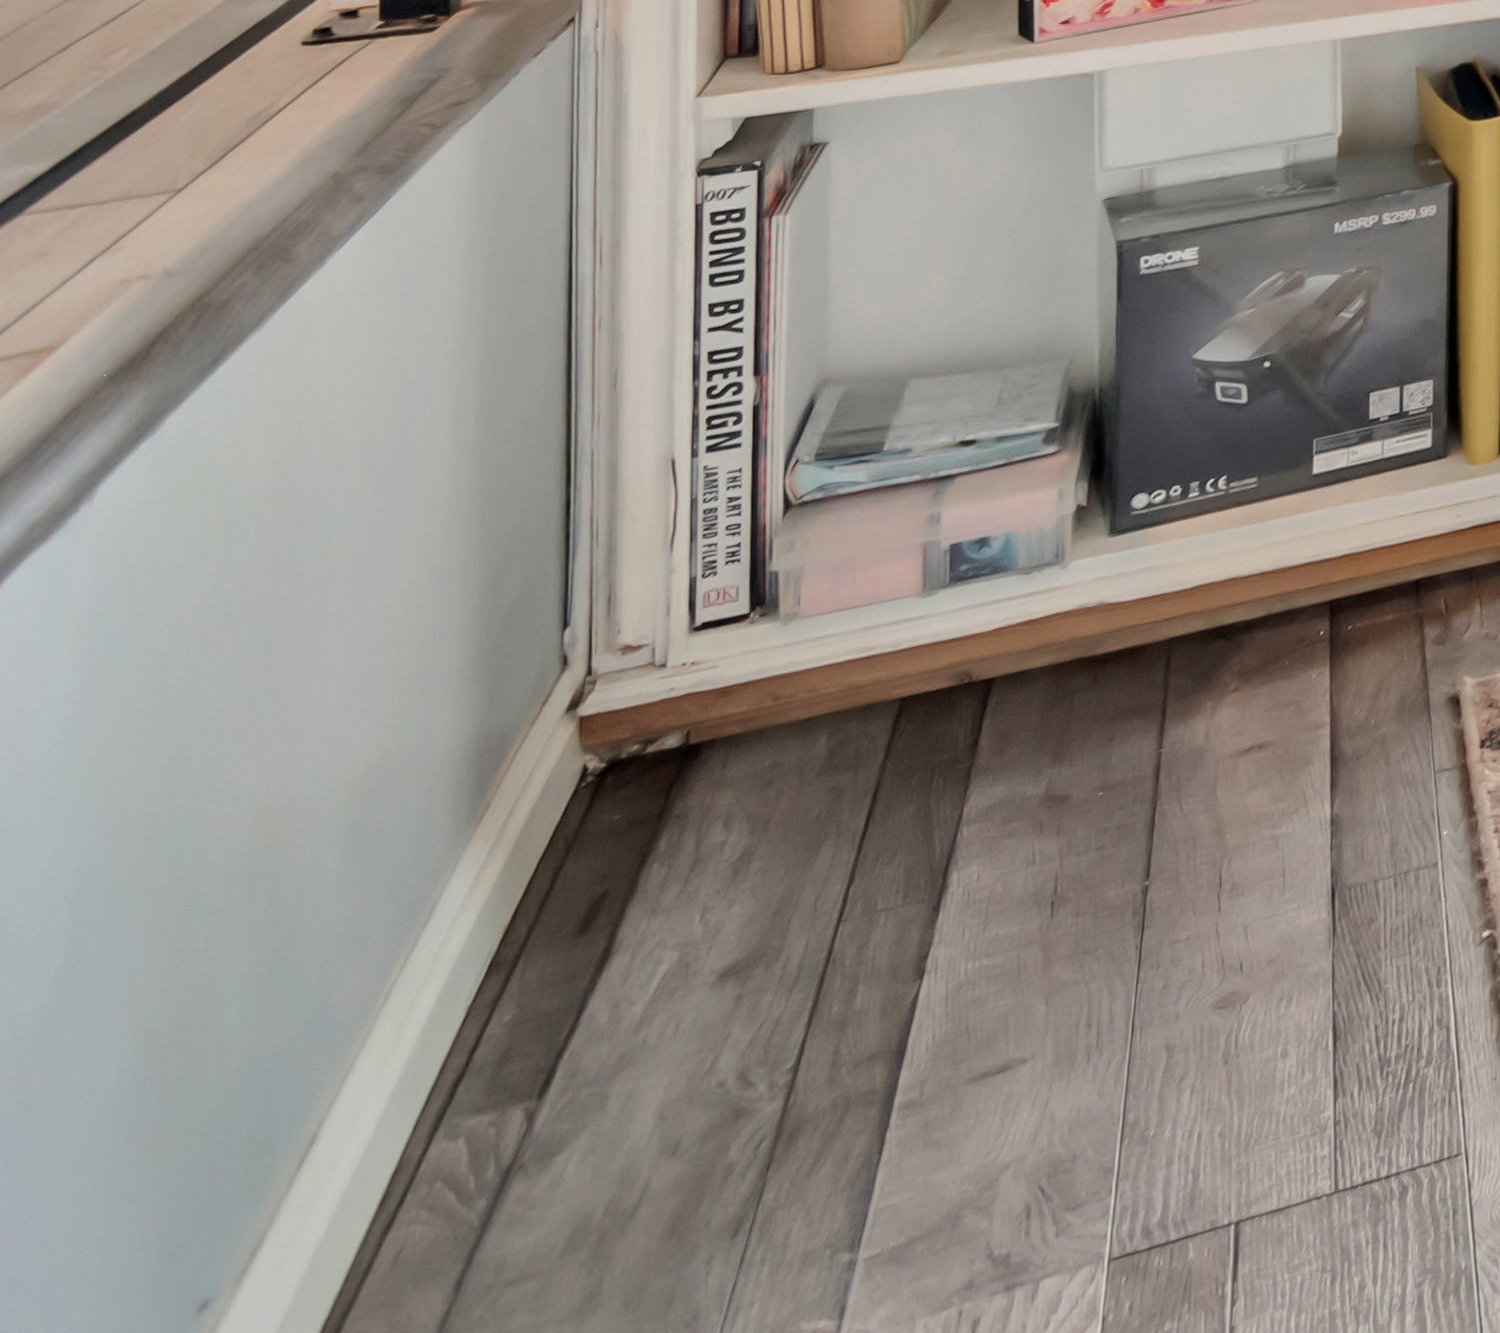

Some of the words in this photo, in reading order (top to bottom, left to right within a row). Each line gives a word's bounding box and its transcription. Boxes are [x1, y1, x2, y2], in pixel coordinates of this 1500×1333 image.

[704, 185, 746, 202] 007
[1334, 215, 1378, 234] MSRP
[1382, 205, 1437, 226] $299.99
[708, 207, 746, 288] BOND
[1139, 246, 1199, 269] DRONE
[707, 299, 745, 333] BY
[705, 346, 744, 454] DESIGN
[703, 465, 719, 505] JAMES
[726, 467, 742, 491] THE
[726, 496, 742, 521] ART
[702, 507, 718, 540] BOND
[725, 523, 742, 538] OF
[701, 542, 718, 579] FILMS
[725, 542, 741, 566] THE
[706, 587, 737, 606] DK
